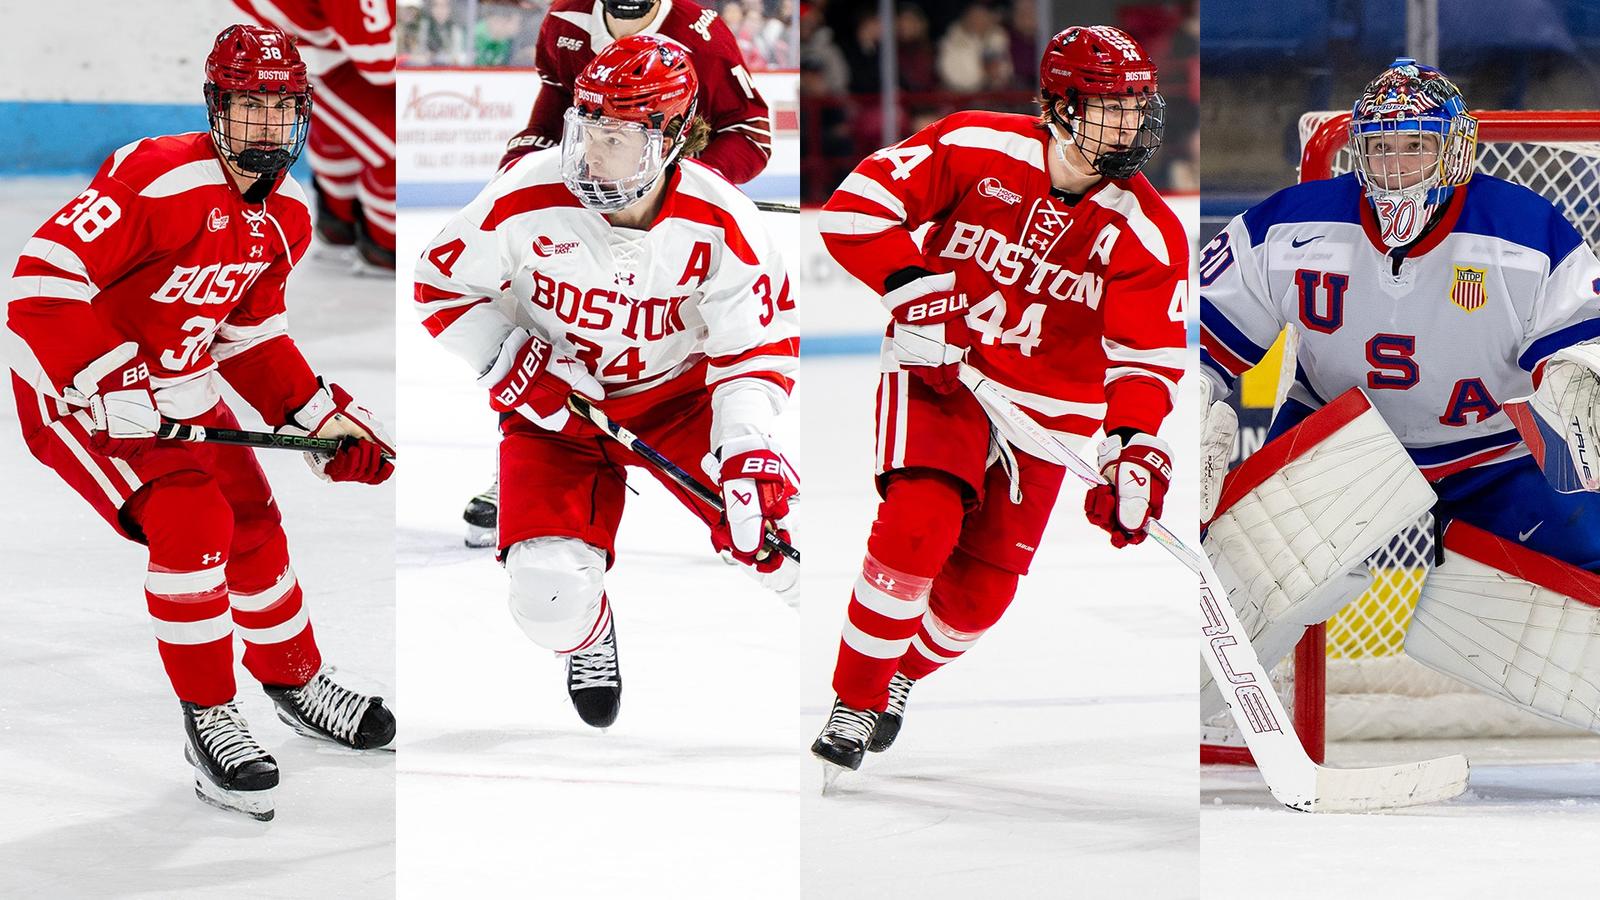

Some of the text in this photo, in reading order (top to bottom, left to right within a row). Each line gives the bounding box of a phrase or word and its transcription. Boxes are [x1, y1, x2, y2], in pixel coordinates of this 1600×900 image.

[258, 70, 290, 81] BOSTON
[261, 47, 282, 60] 38
[591, 65, 613, 81] 34
[1122, 49, 1141, 61] 44
[578, 88, 604, 105] BOSTON
[1125, 71, 1151, 81] BOSTON
[55, 188, 121, 242] 38
[1375, 198, 1418, 242] 30
[554, 241, 580, 250] HOCKEY
[677, 241, 711, 286] A
[1088, 222, 1121, 265] A
[939, 221, 1104, 311] BOSTON
[1459, 271, 1481, 281] NTDP
[531, 270, 691, 342] BOSTON
[964, 290, 1047, 357] 44
[1294, 268, 1349, 335] U
[565, 332, 646, 380] 34
[1365, 333, 1420, 391] S
[1438, 376, 1503, 428] A
[293, 437, 337, 449] GHOST
[1572, 415, 1593, 485] TRUE
